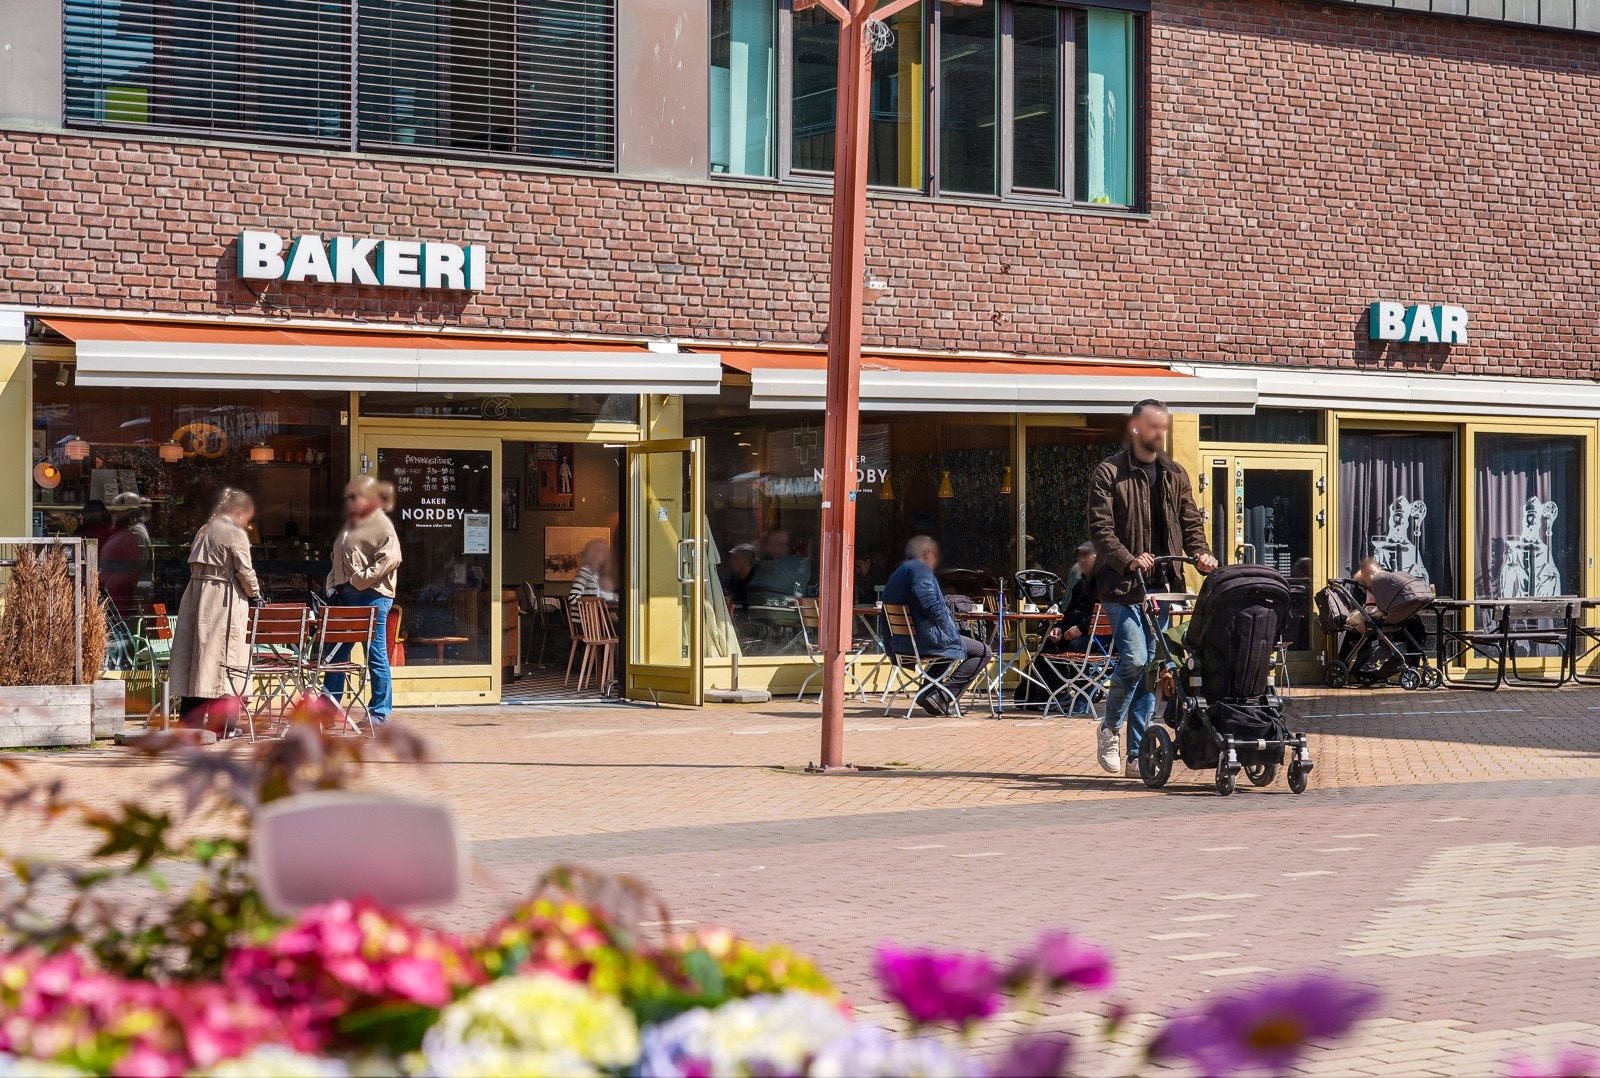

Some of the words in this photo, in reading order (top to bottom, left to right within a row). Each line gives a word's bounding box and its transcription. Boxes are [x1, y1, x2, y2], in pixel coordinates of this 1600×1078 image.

[238, 230, 486, 291] BAKERI
[1371, 302, 1468, 344] BAR
[813, 467, 888, 483] NDBY
[421, 497, 446, 505] BAKER
[402, 508, 465, 520] NORDBY
